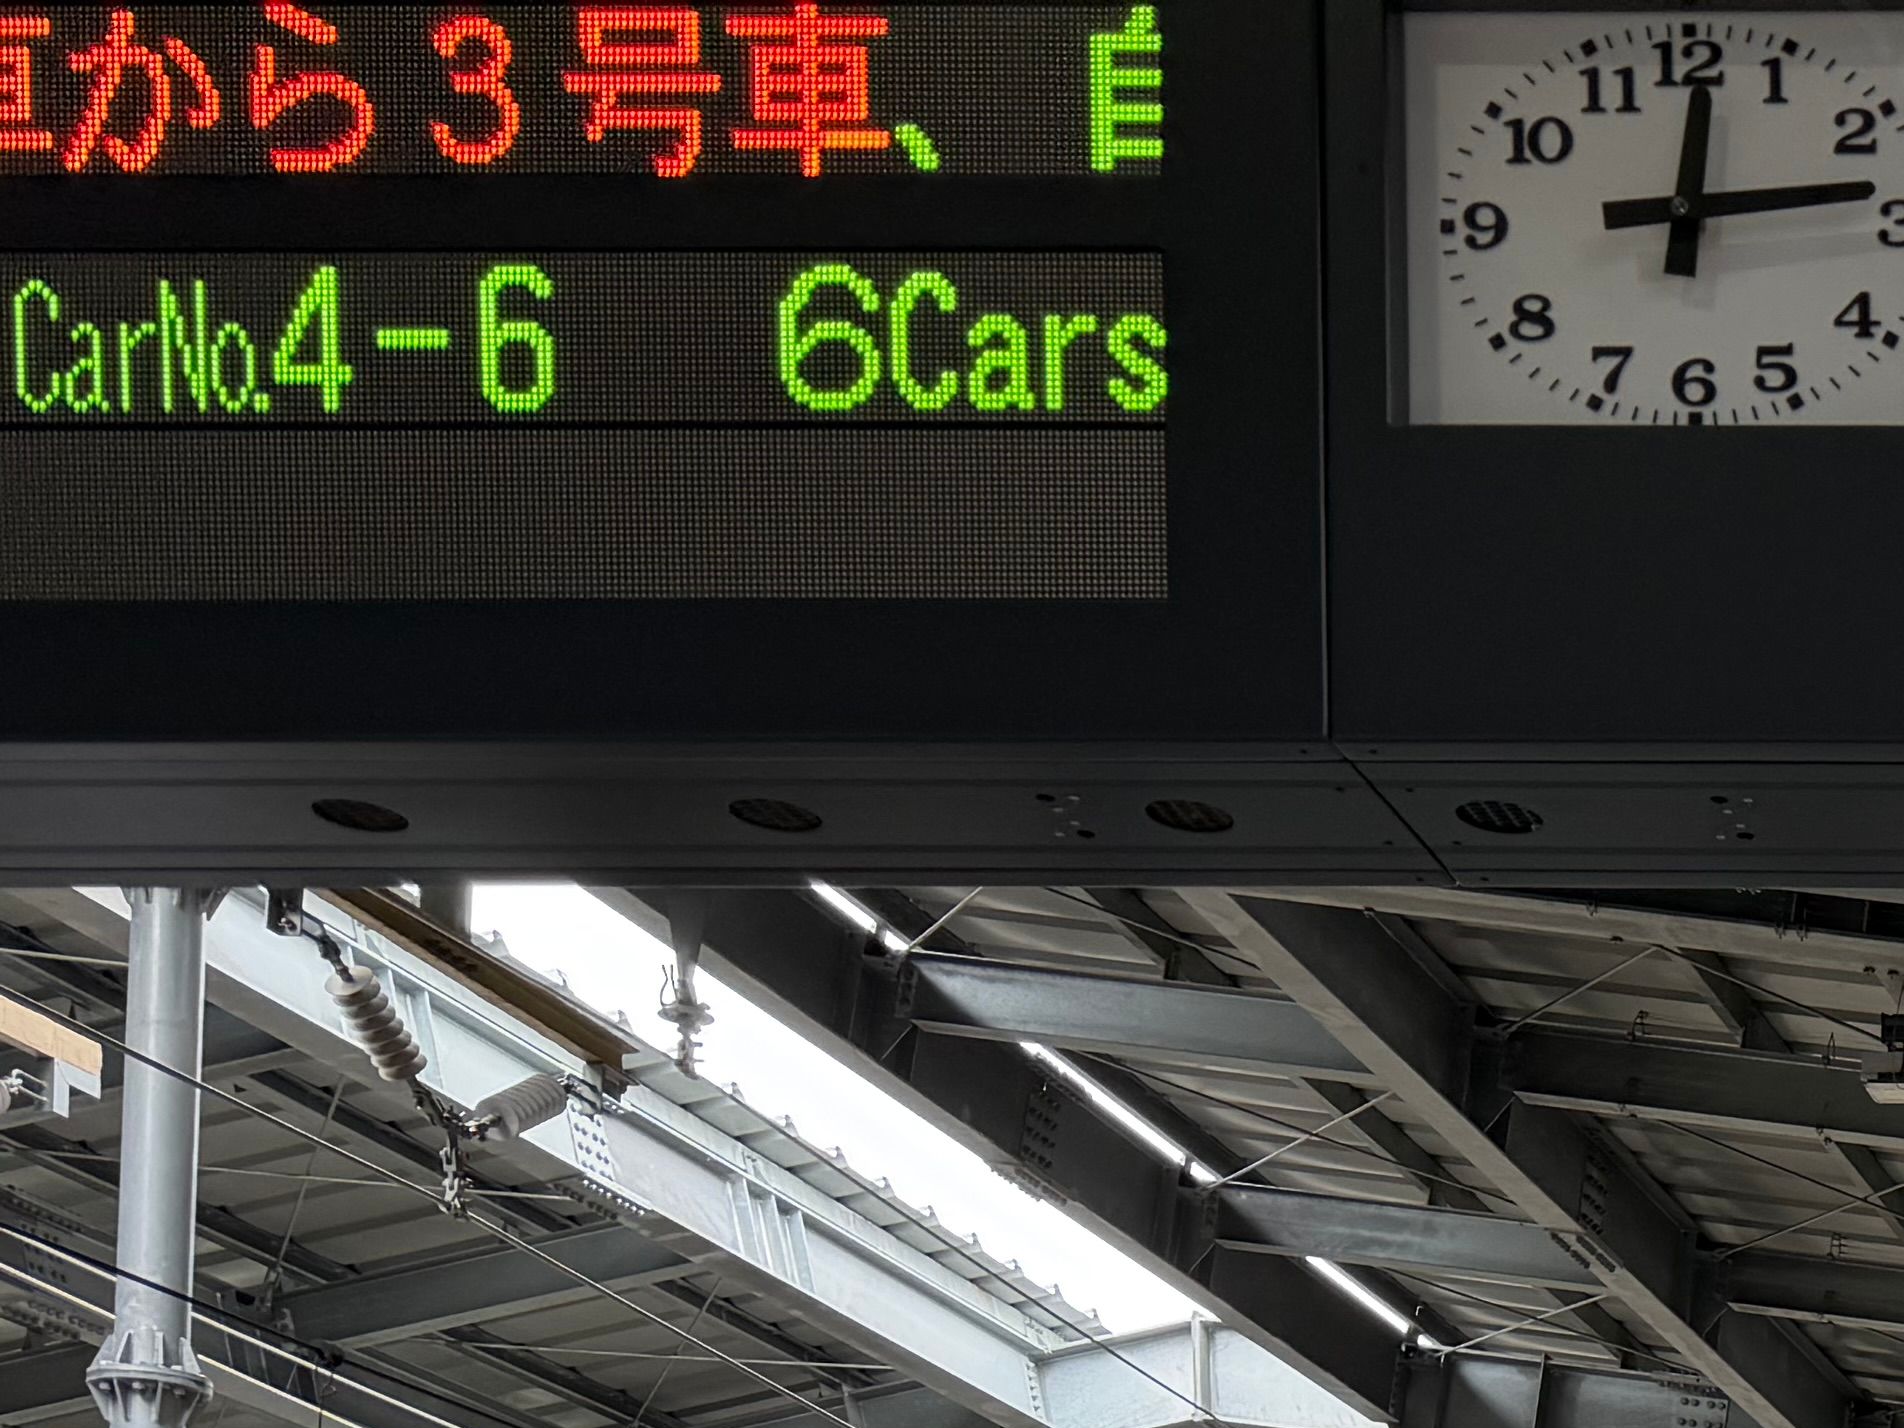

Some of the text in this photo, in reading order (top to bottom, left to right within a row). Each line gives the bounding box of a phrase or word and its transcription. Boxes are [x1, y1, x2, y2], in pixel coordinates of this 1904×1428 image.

[1650, 39, 1725, 88] 12
[1760, 56, 1789, 104] 1
[1579, 66, 1641, 114] 11
[1503, 116, 1574, 165] 10
[1833, 107, 1878, 155] 2
[1462, 202, 1509, 250] 9
[777, 263, 1168, 411] 6Cars
[1508, 293, 1556, 342] 8
[1832, 292, 1881, 338] 4
[1591, 345, 1634, 395] 7
[1671, 357, 1718, 407] 6
[1753, 342, 1798, 393] 5
